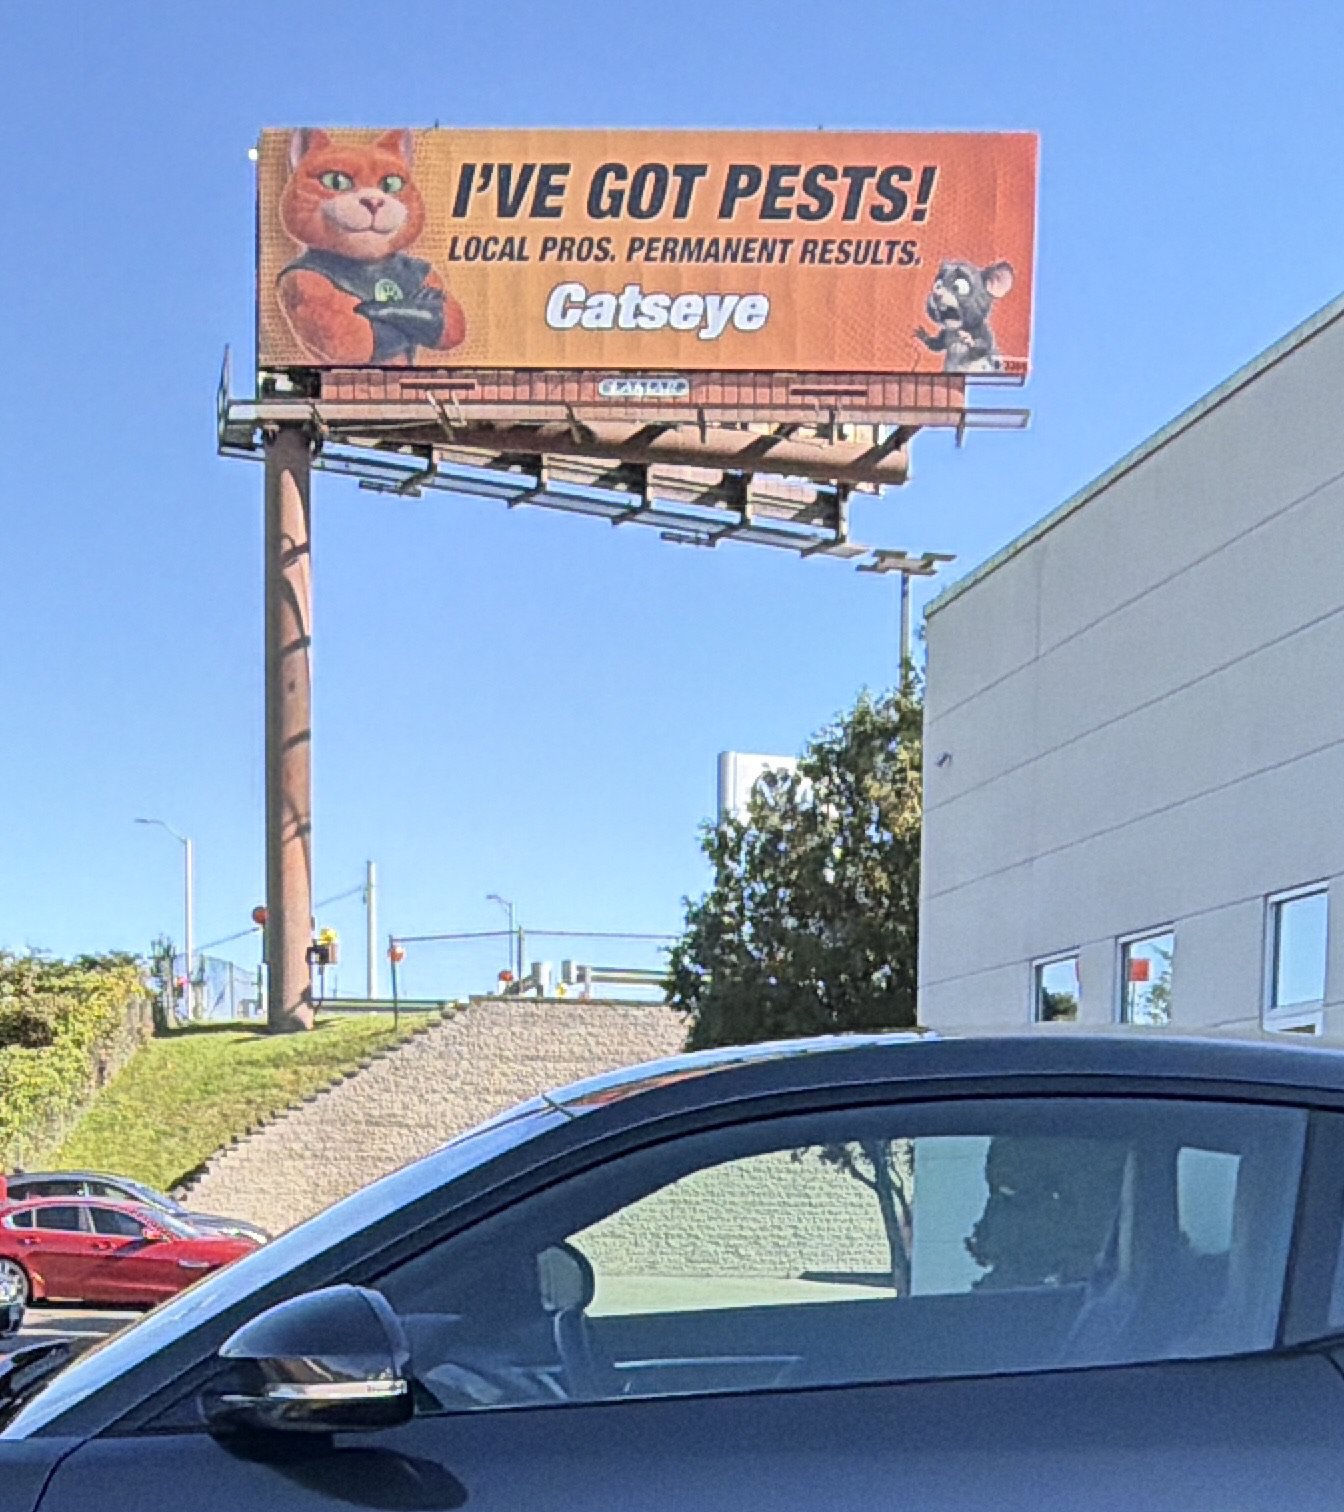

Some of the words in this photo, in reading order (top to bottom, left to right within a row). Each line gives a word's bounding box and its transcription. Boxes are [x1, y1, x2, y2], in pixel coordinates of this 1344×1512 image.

[451, 162, 572, 219] I'VE
[586, 162, 709, 220] GOT
[717, 164, 938, 223] PESTS!
[447, 235, 530, 263] LOCAL
[538, 235, 616, 263] PROS.
[625, 236, 795, 265] PERMANENT
[798, 238, 923, 266] RESULTS.
[545, 281, 771, 341] Catseye
